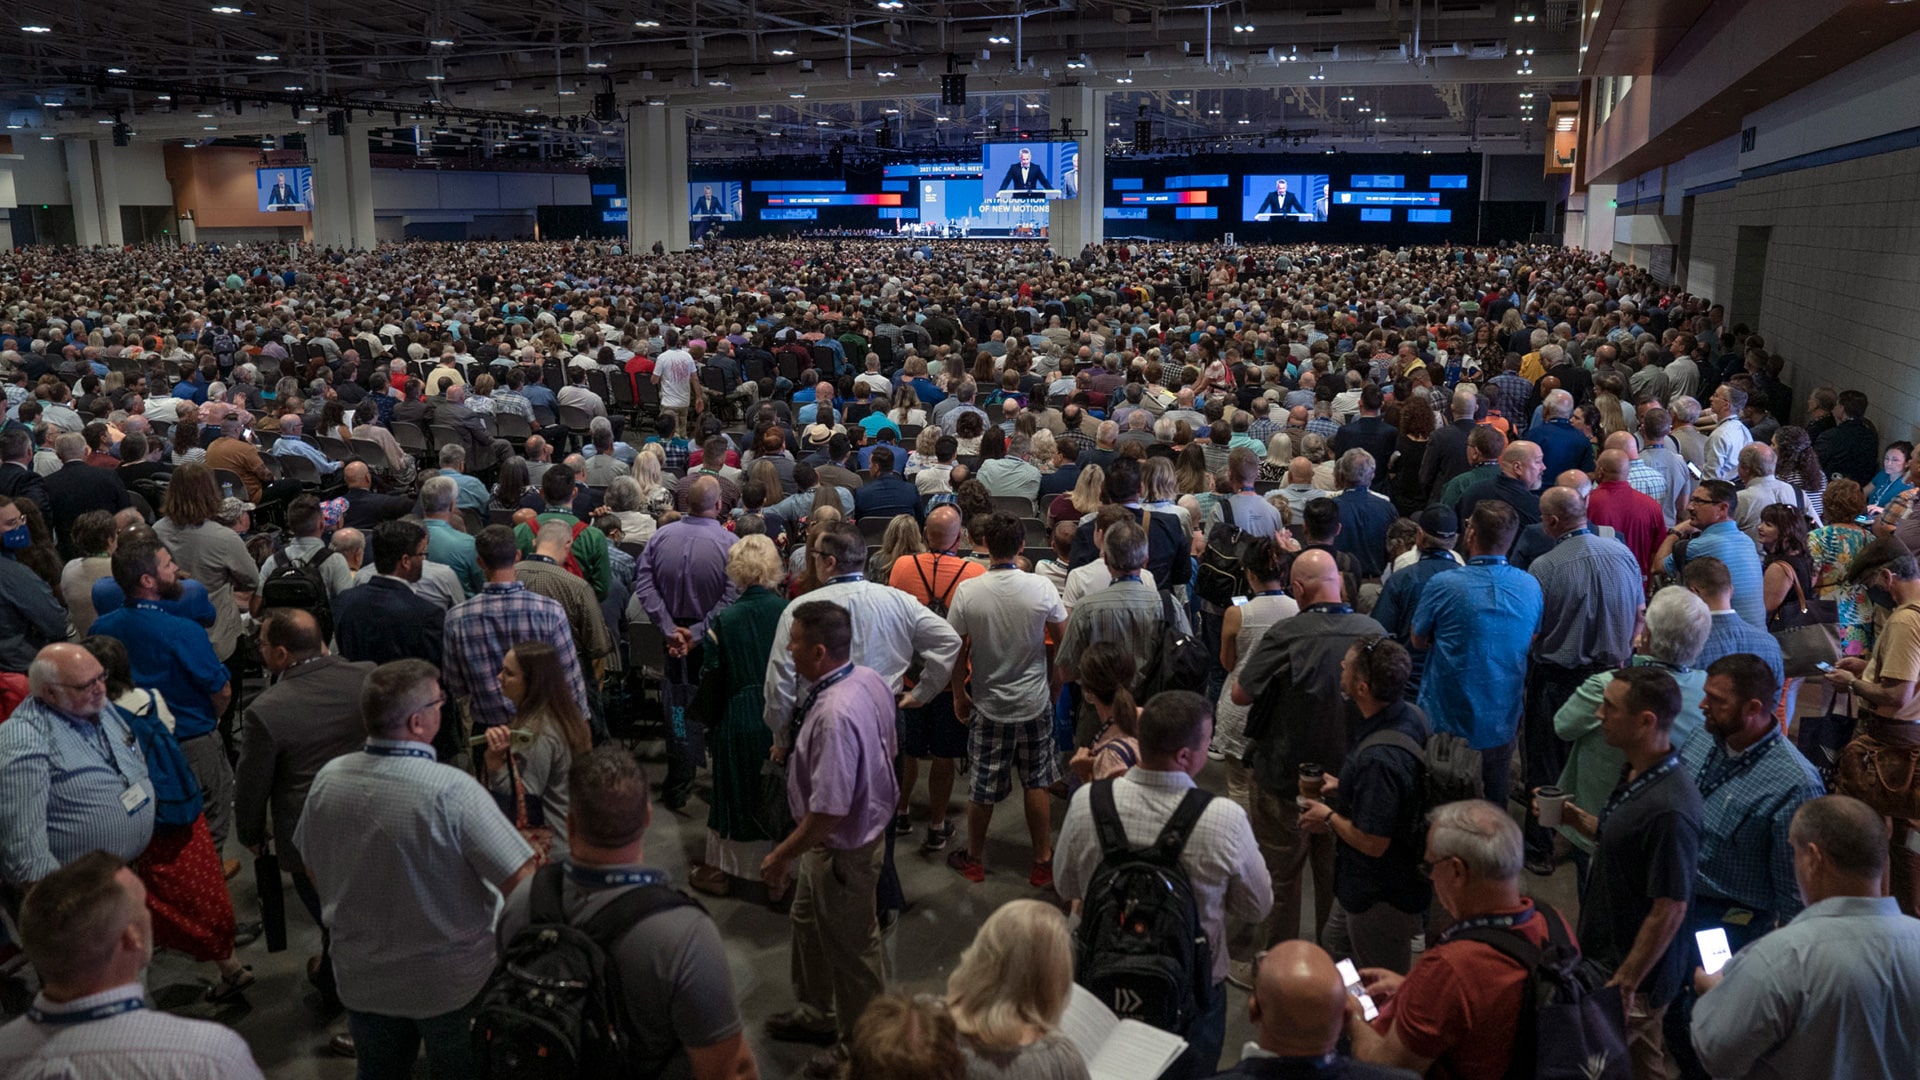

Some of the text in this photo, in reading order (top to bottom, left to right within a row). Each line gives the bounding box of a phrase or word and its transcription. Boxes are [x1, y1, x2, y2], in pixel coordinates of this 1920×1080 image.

[978, 205, 1050, 213] OF NEW MOTIONS
